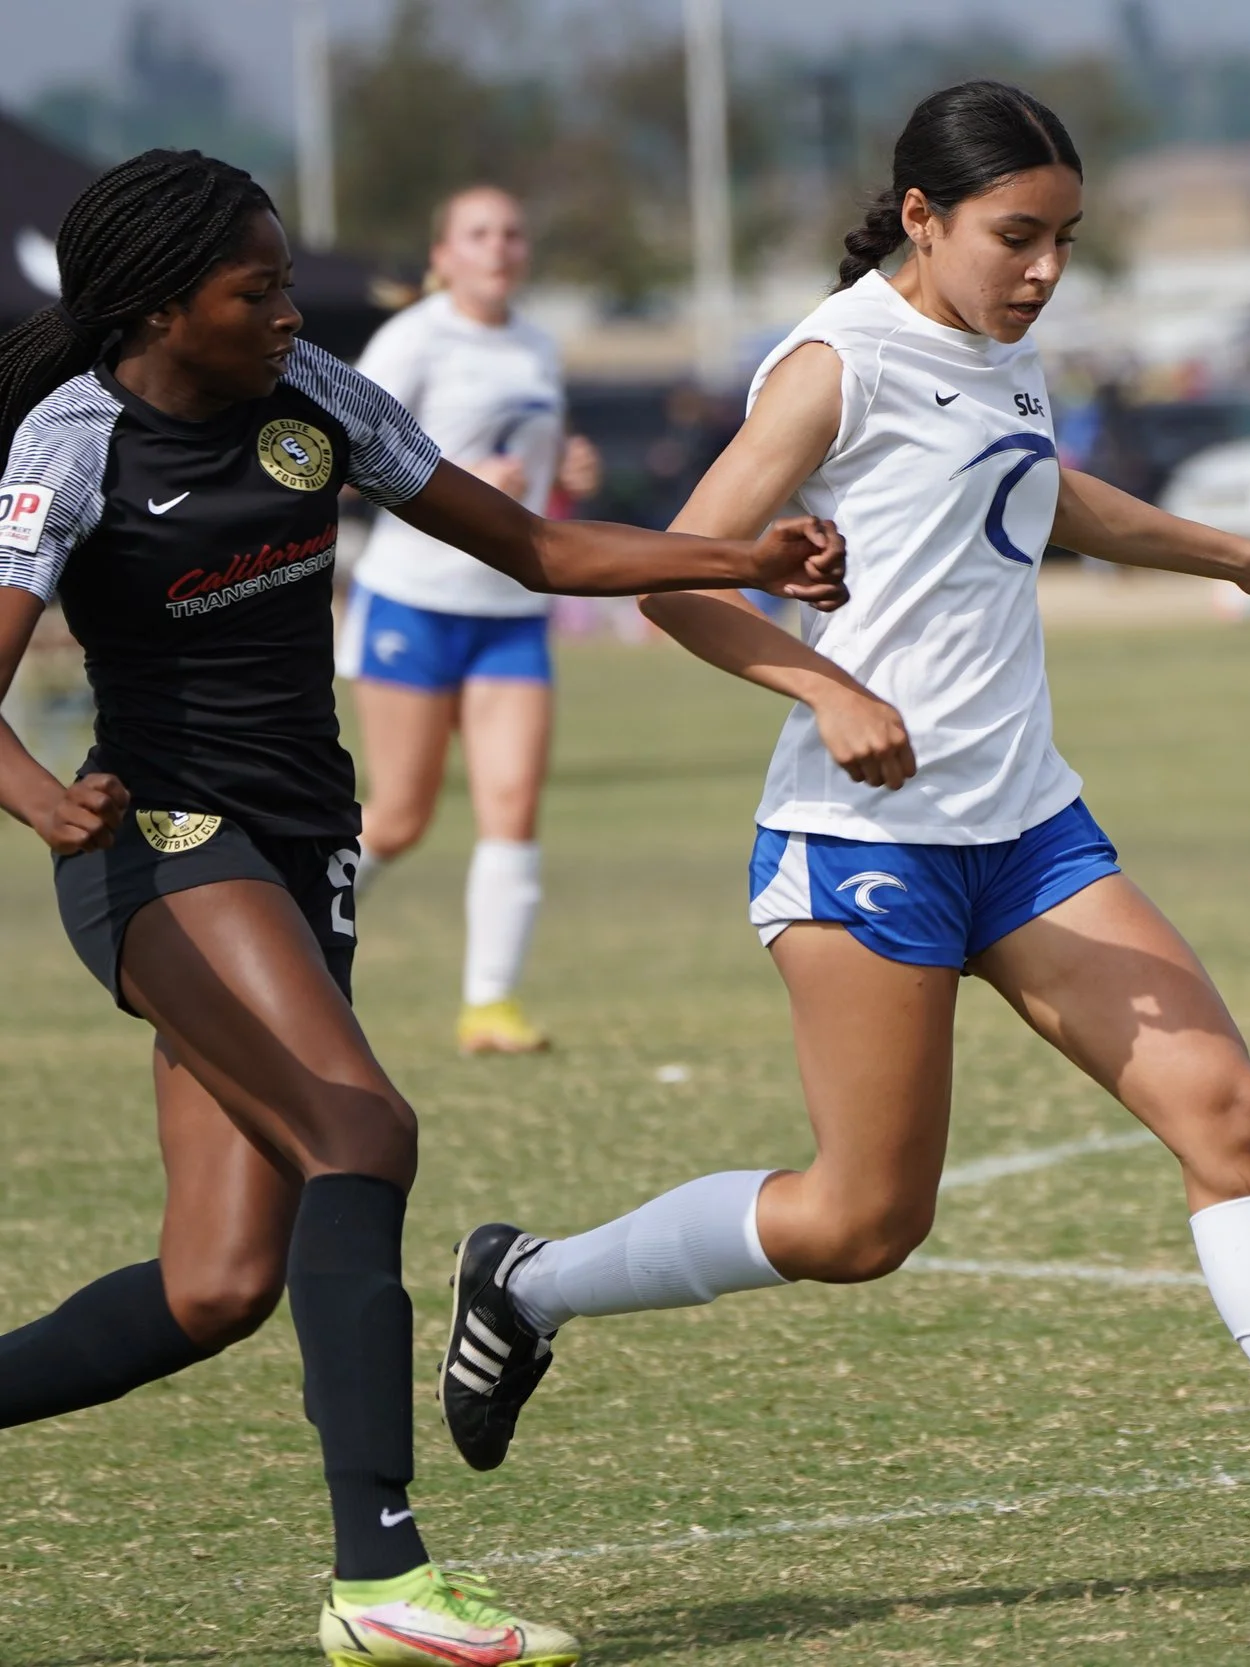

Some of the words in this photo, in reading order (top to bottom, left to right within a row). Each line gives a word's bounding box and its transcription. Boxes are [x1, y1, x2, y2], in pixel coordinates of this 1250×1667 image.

[260, 425, 279, 453] SOCAL
[280, 421, 309, 433] ELITE
[275, 470, 325, 489] FOOTBALL
[151, 834, 203, 850] FOOTBALL
[201, 816, 218, 835] CLU
